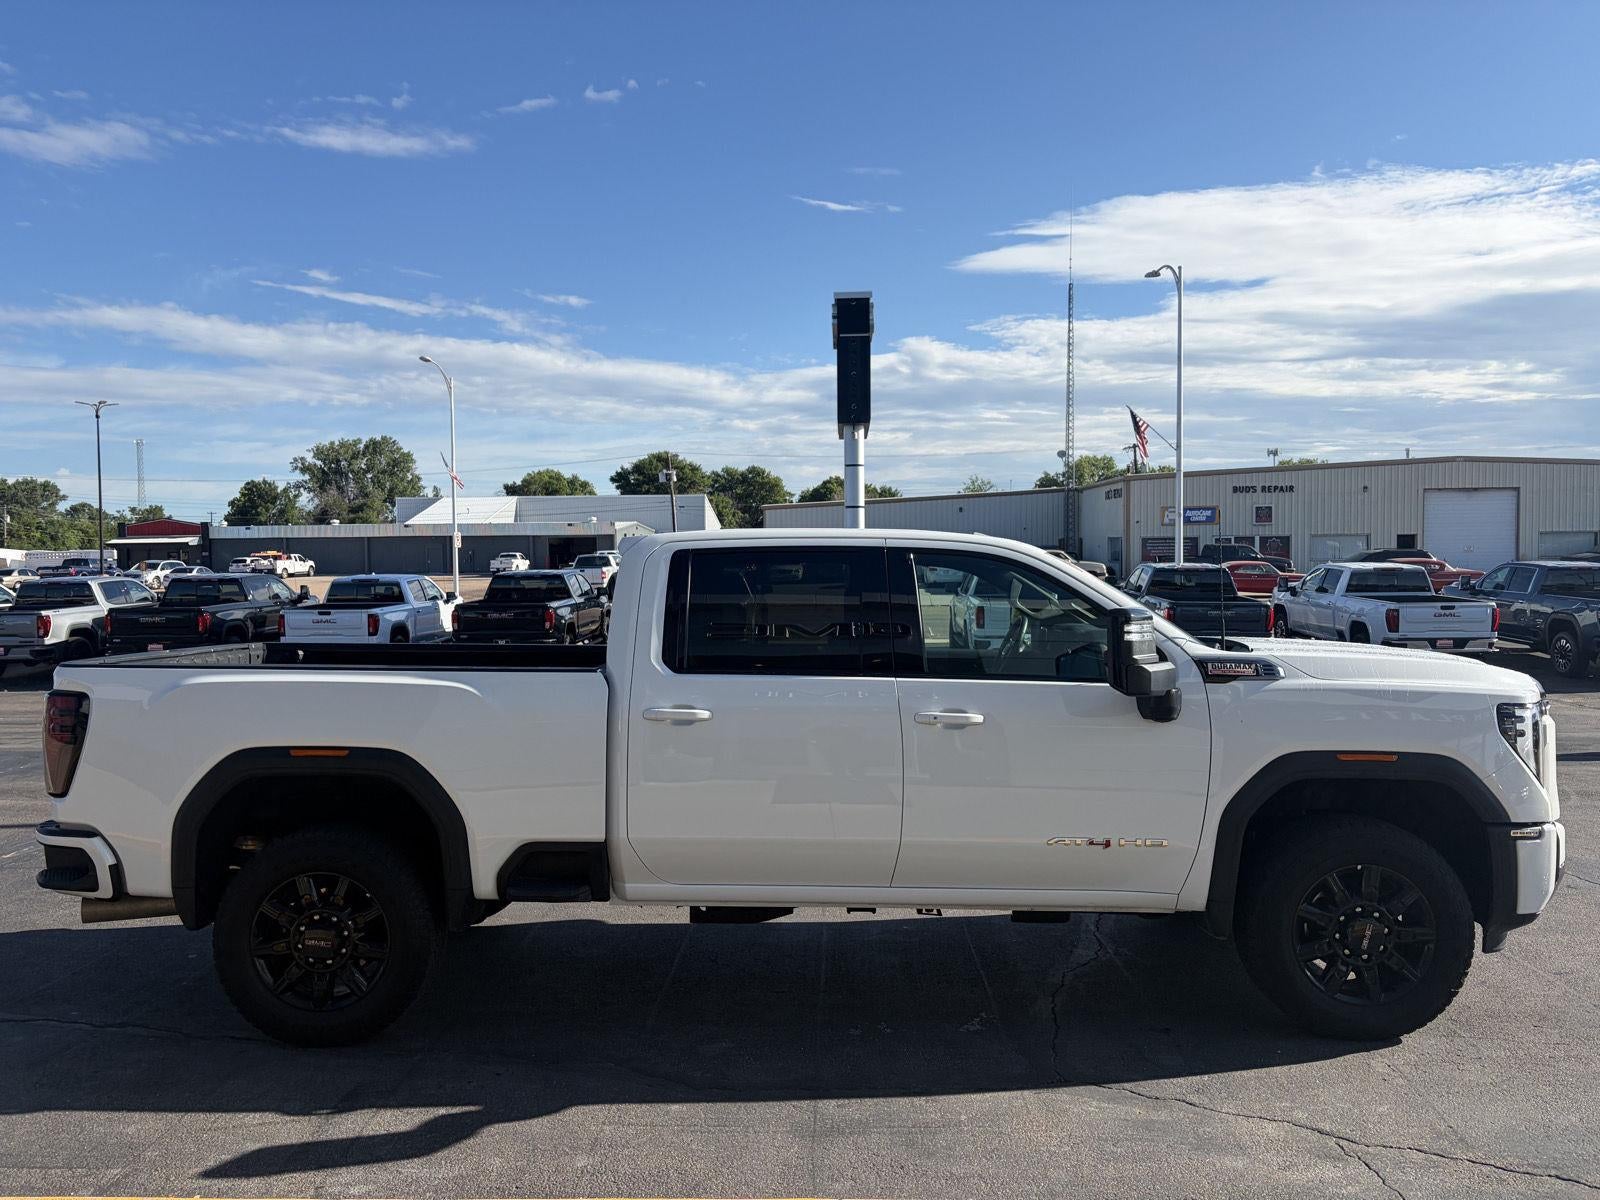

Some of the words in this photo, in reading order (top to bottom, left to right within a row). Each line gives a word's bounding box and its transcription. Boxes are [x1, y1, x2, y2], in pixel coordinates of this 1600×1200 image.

[1232, 485, 1257, 494] BUD'S
[1261, 485, 1295, 493] REPAIR
[1047, 836, 1111, 850] AT4
[1119, 838, 1168, 848] HD
